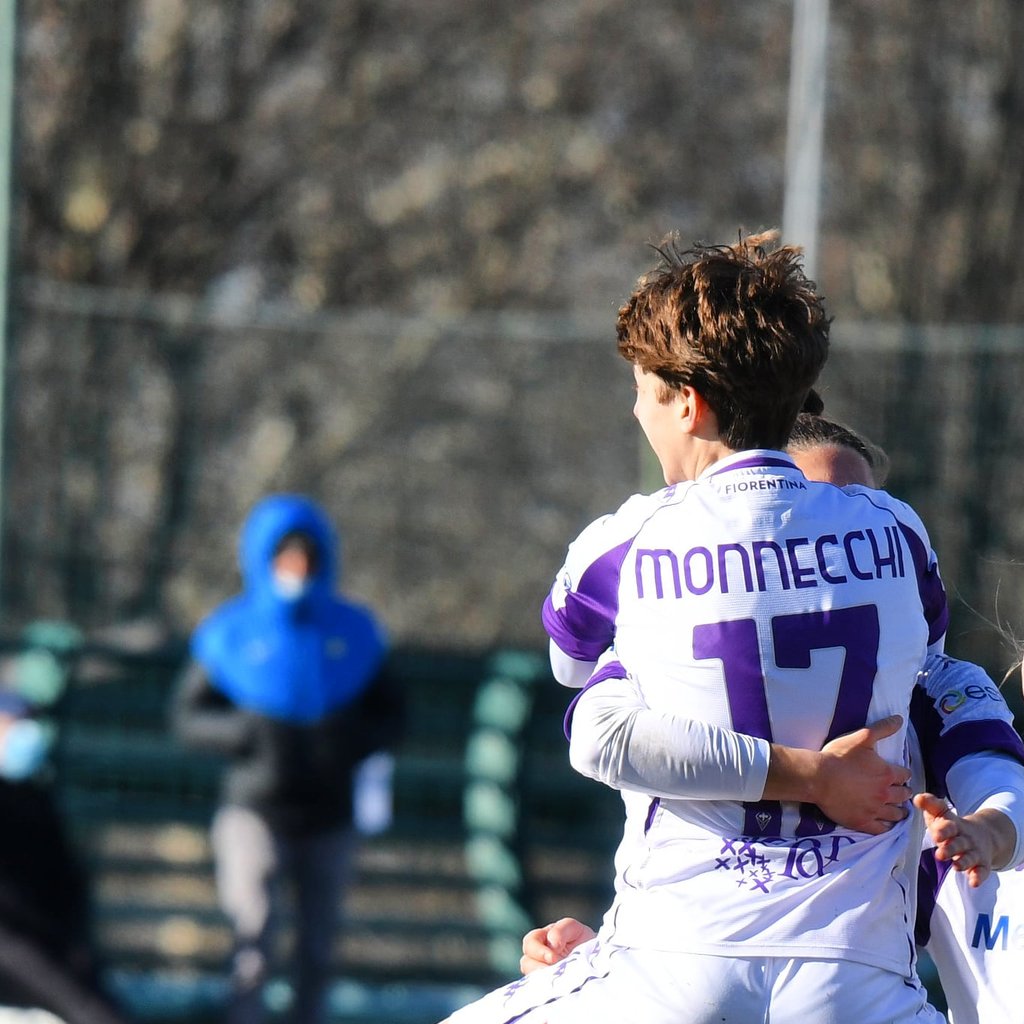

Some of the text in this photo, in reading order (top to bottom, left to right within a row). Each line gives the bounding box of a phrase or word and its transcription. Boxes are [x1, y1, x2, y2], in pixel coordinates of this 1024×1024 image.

[724, 479, 807, 495] FIORENTINA
[635, 526, 906, 600] MONNECCHI
[692, 603, 881, 836] 17
